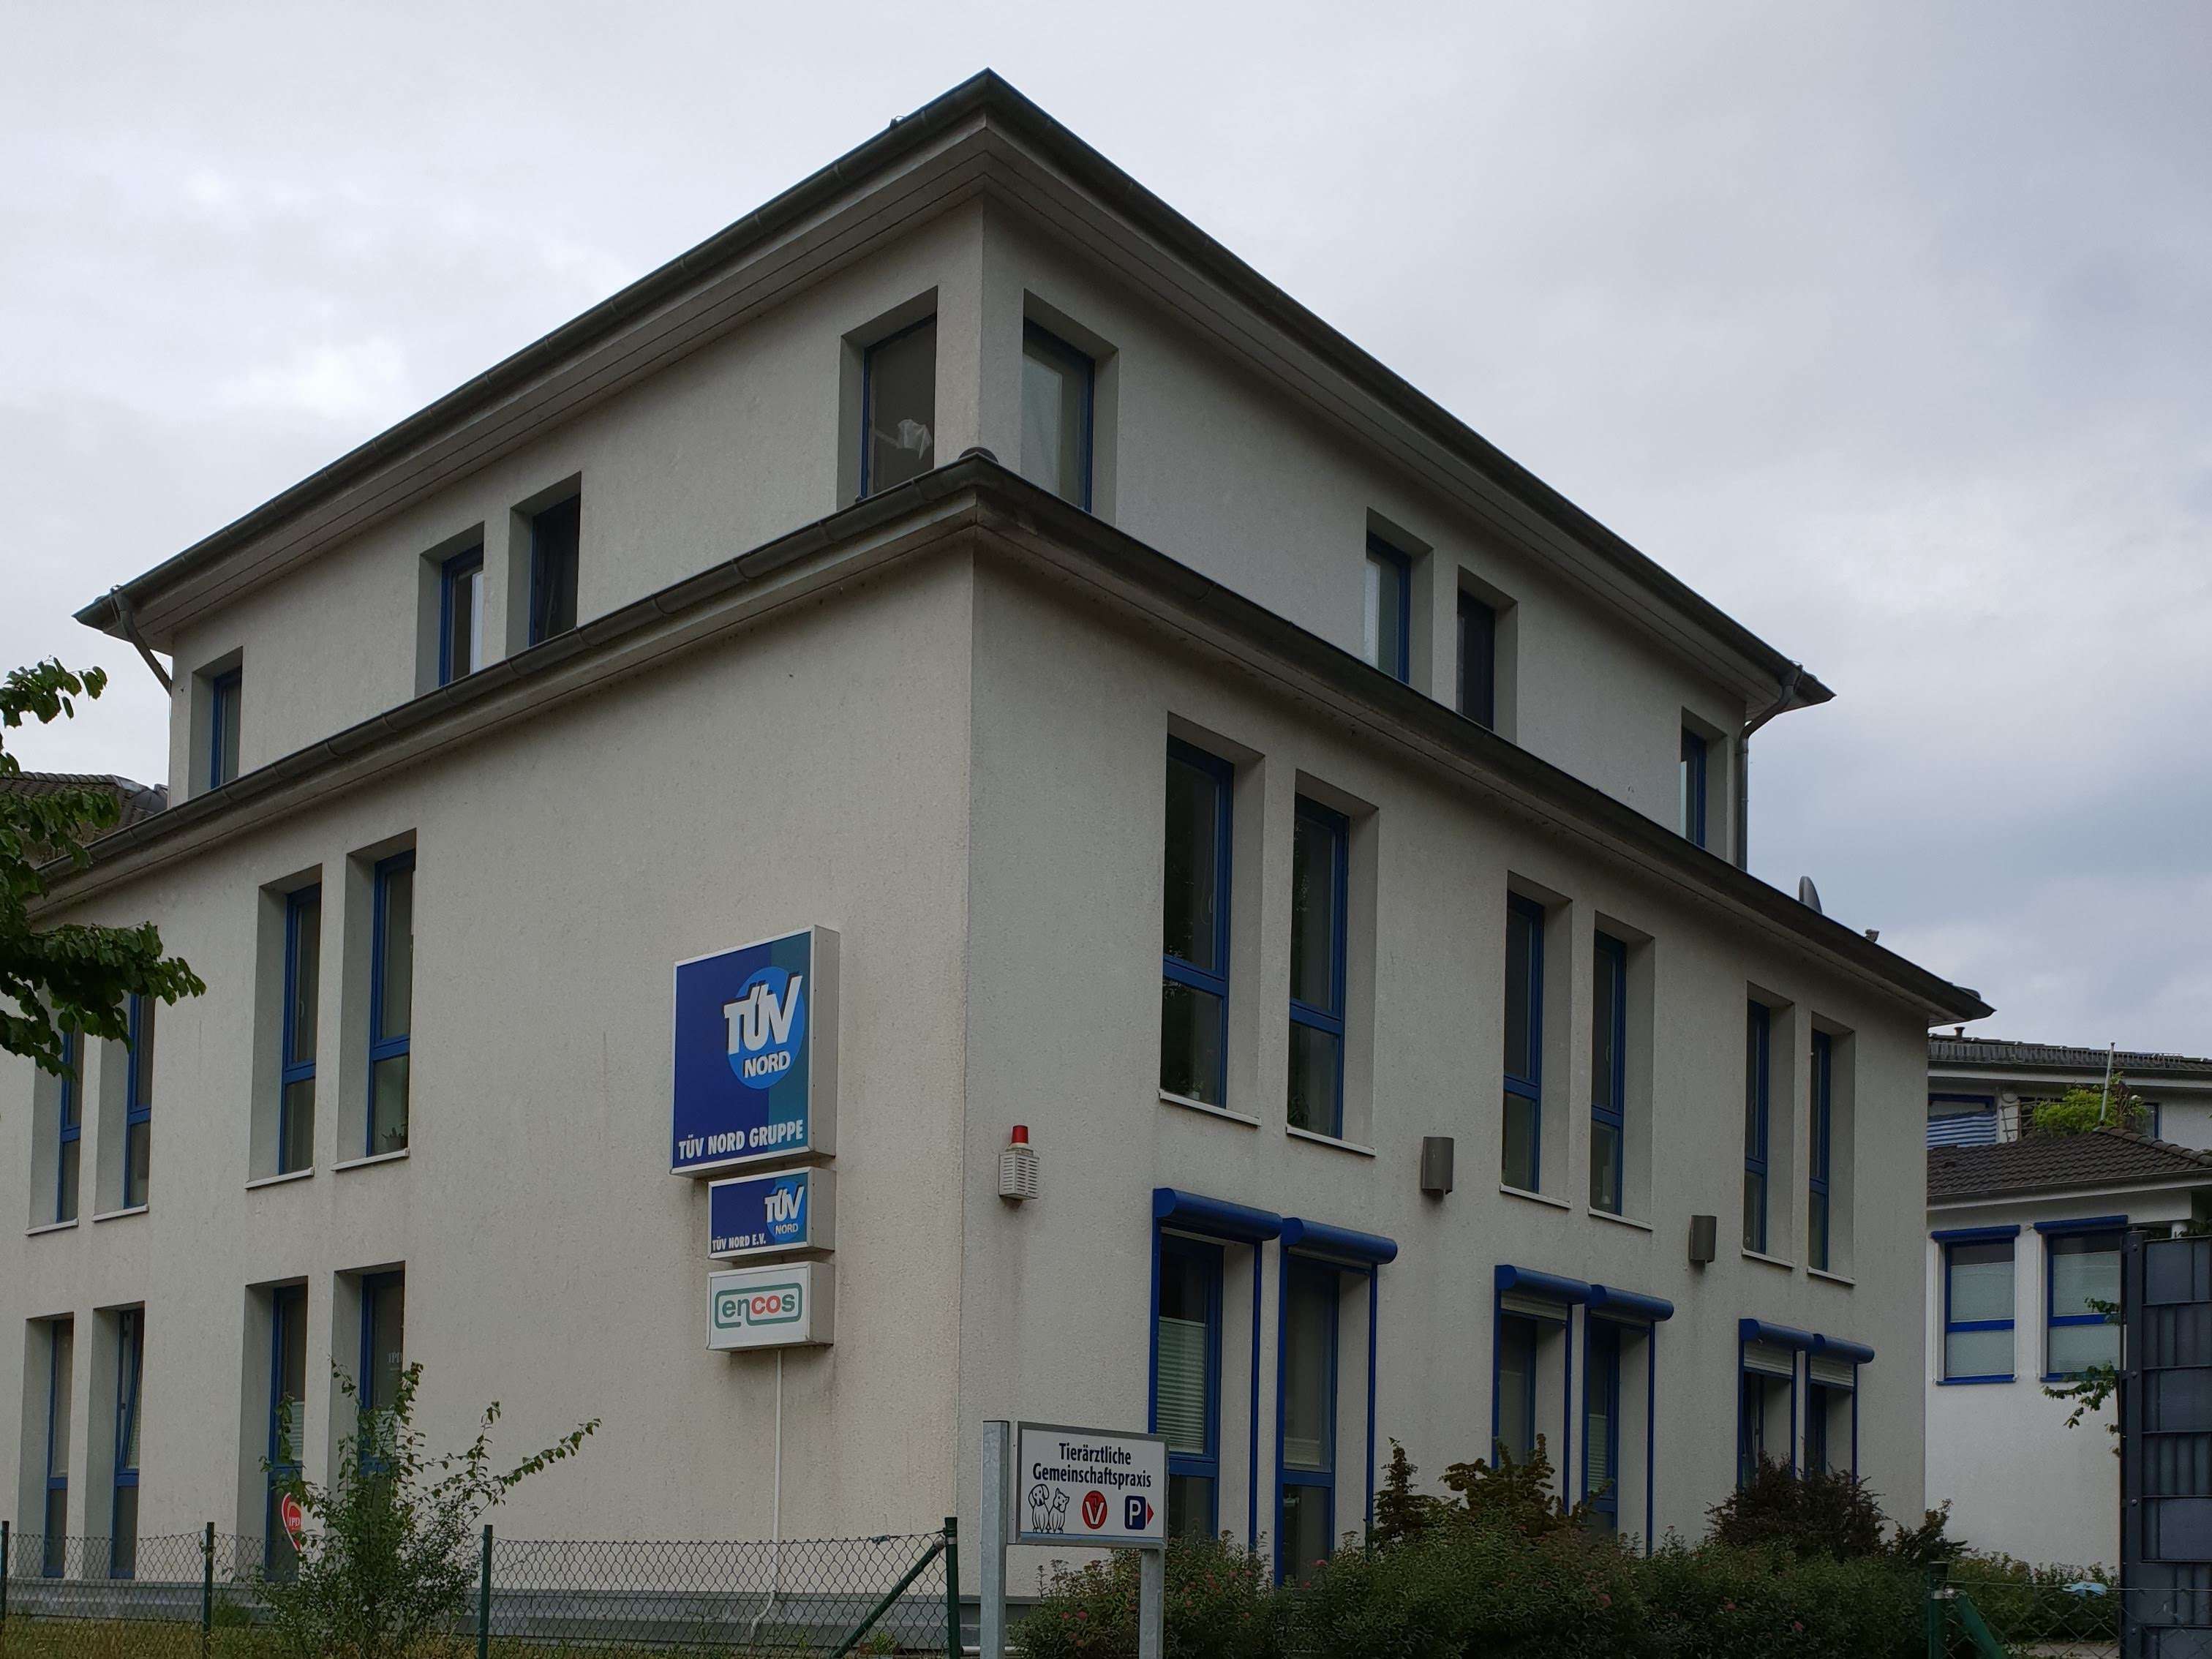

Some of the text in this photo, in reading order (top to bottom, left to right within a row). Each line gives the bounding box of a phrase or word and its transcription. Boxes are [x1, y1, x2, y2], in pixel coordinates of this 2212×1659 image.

[723, 974, 803, 1055] TÜV
[744, 1052, 791, 1078] NORD
[678, 1119, 804, 1160] TÜV NORD GRUPPE
[764, 1186, 805, 1223] TÜV
[775, 1223, 799, 1235] NORD
[712, 1233, 767, 1252] TÜV NORD E.V.
[721, 1293, 796, 1318] encos
[1059, 1442, 1132, 1465] Tierärztliche
[1032, 1462, 1151, 1490] Gemeinschaftspraxis
[1129, 1500, 1142, 1526] P
